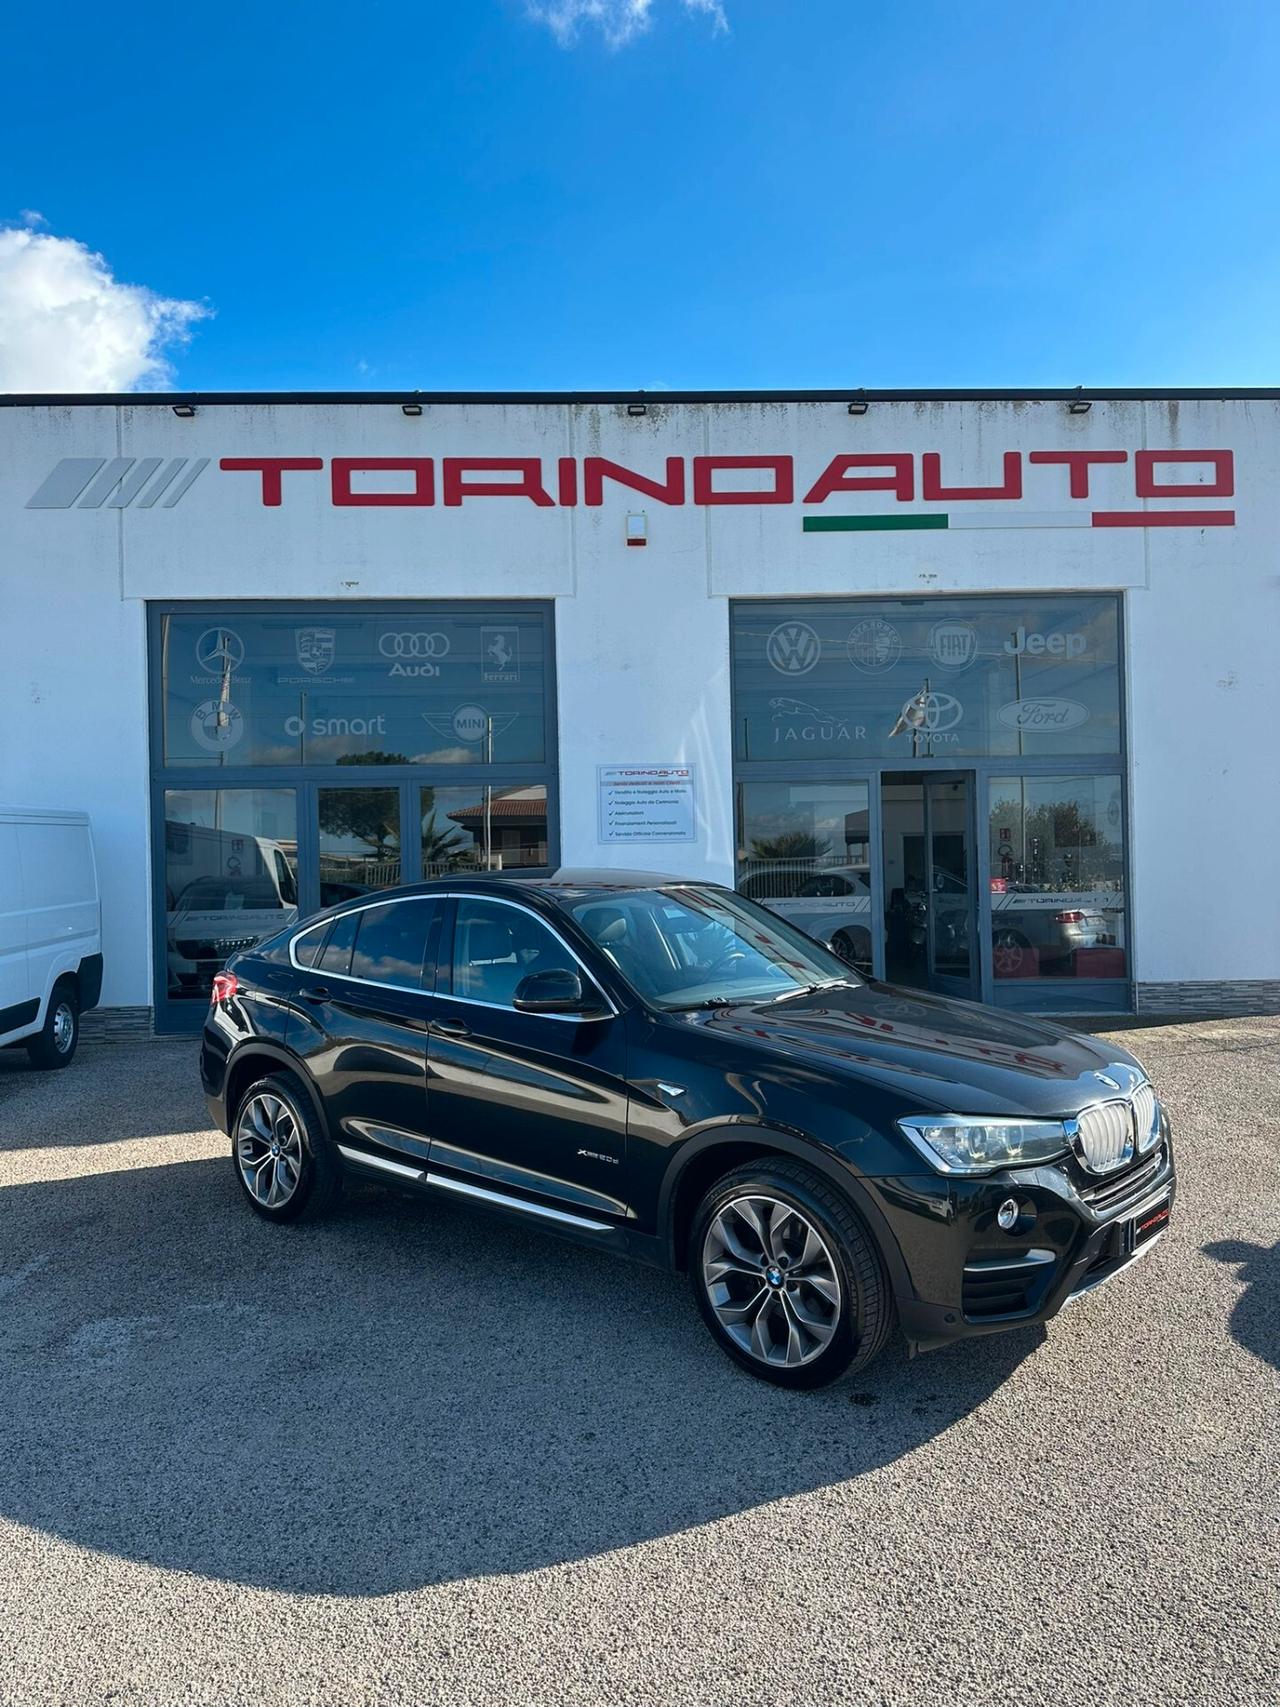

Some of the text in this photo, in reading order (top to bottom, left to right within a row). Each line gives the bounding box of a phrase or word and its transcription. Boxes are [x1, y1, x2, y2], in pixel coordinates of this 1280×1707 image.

[220, 449, 1235, 507] TORINOAUTO
[939, 634, 969, 657] FIAT
[1003, 626, 1087, 660] Jeep
[388, 663, 440, 677] Audi
[484, 672, 517, 681] Ferrari
[190, 675, 251, 685] MercedeBenz
[277, 676, 355, 684] PORSCHE
[1017, 703, 1070, 725] Ford
[312, 715, 386, 736] smart
[456, 718, 485, 729] MINI
[774, 727, 867, 743] JAGUAR
[906, 733, 960, 743] TOYOTA
